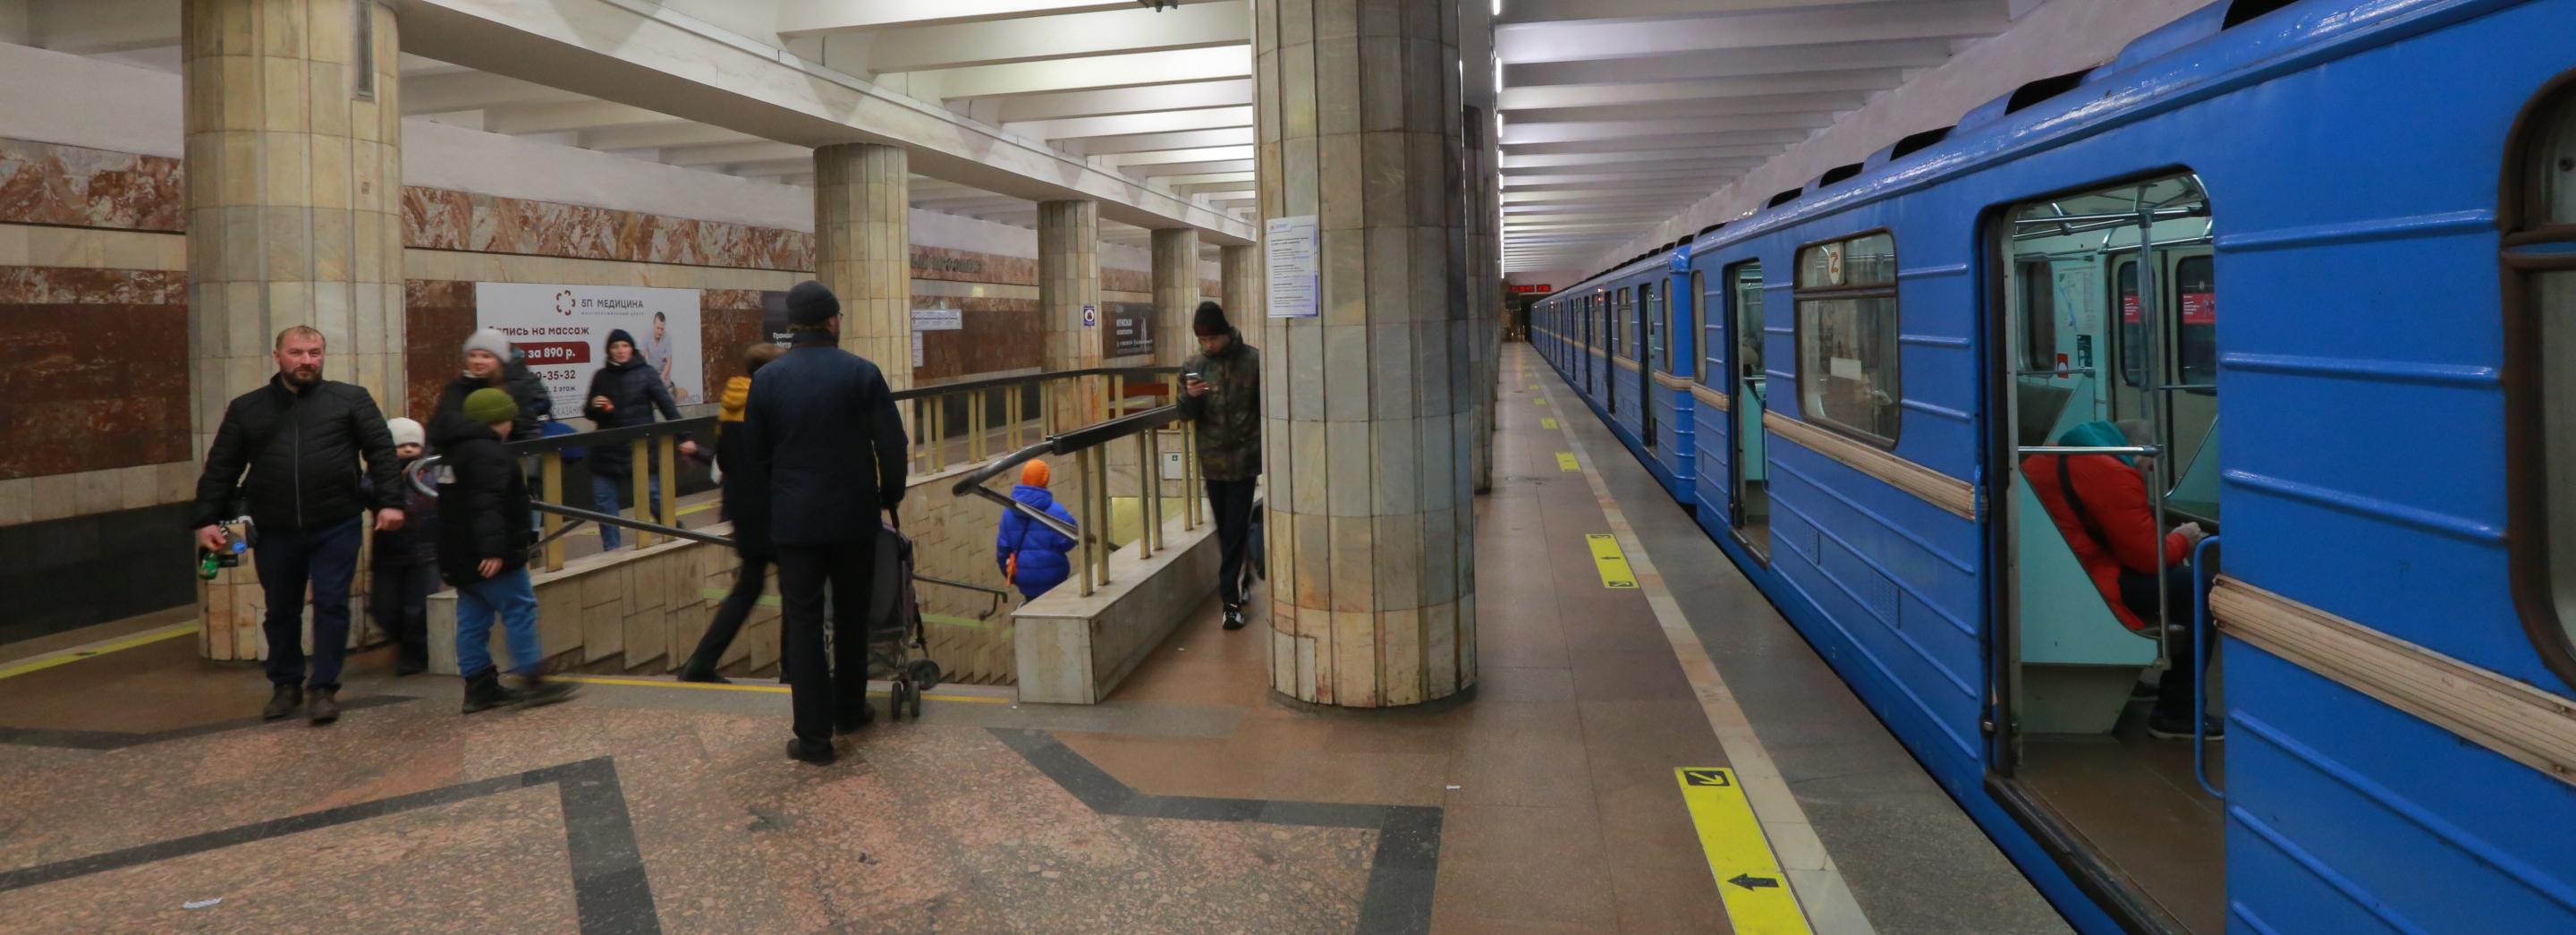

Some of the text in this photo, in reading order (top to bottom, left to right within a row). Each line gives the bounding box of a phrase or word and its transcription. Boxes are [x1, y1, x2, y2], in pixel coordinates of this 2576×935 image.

[1831, 251, 1839, 273] 2
[597, 299, 644, 310] МЕДИЦИНА
[487, 326, 589, 336] пись на массаж
[528, 350, 541, 358] за
[544, 347, 564, 357] 890
[565, 349, 576, 361] р.
